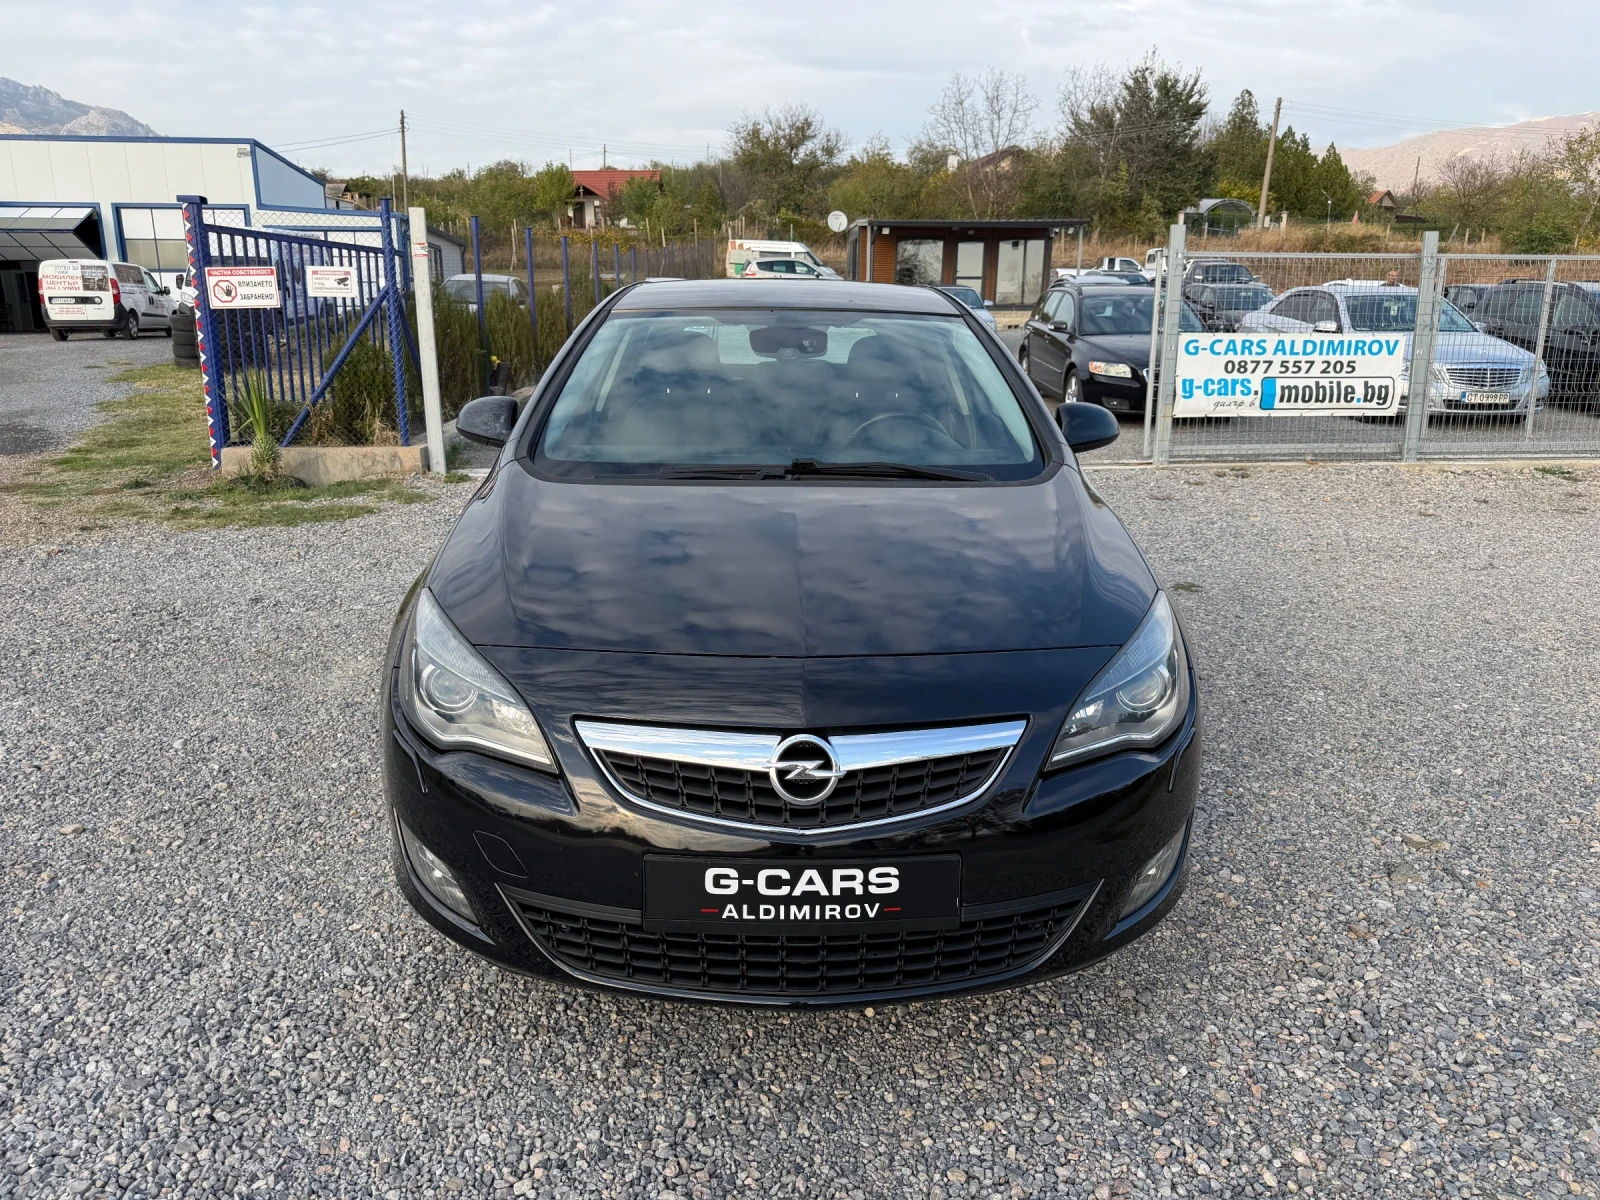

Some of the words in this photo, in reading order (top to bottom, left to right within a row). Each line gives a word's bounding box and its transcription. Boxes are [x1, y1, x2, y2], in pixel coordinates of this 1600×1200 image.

[237, 280, 273, 288] ВЛИЗАНЕТО
[1184, 339, 1268, 356] G-CARS
[1272, 339, 1400, 356] ALDIMIROV
[1223, 360, 1274, 374] 0877
[1278, 360, 1315, 374] 557
[1319, 360, 1357, 374] 205
[1279, 381, 1390, 405] mobile.bg
[704, 866, 900, 896] G-CARS
[721, 903, 880, 920] ALDIMIROV
